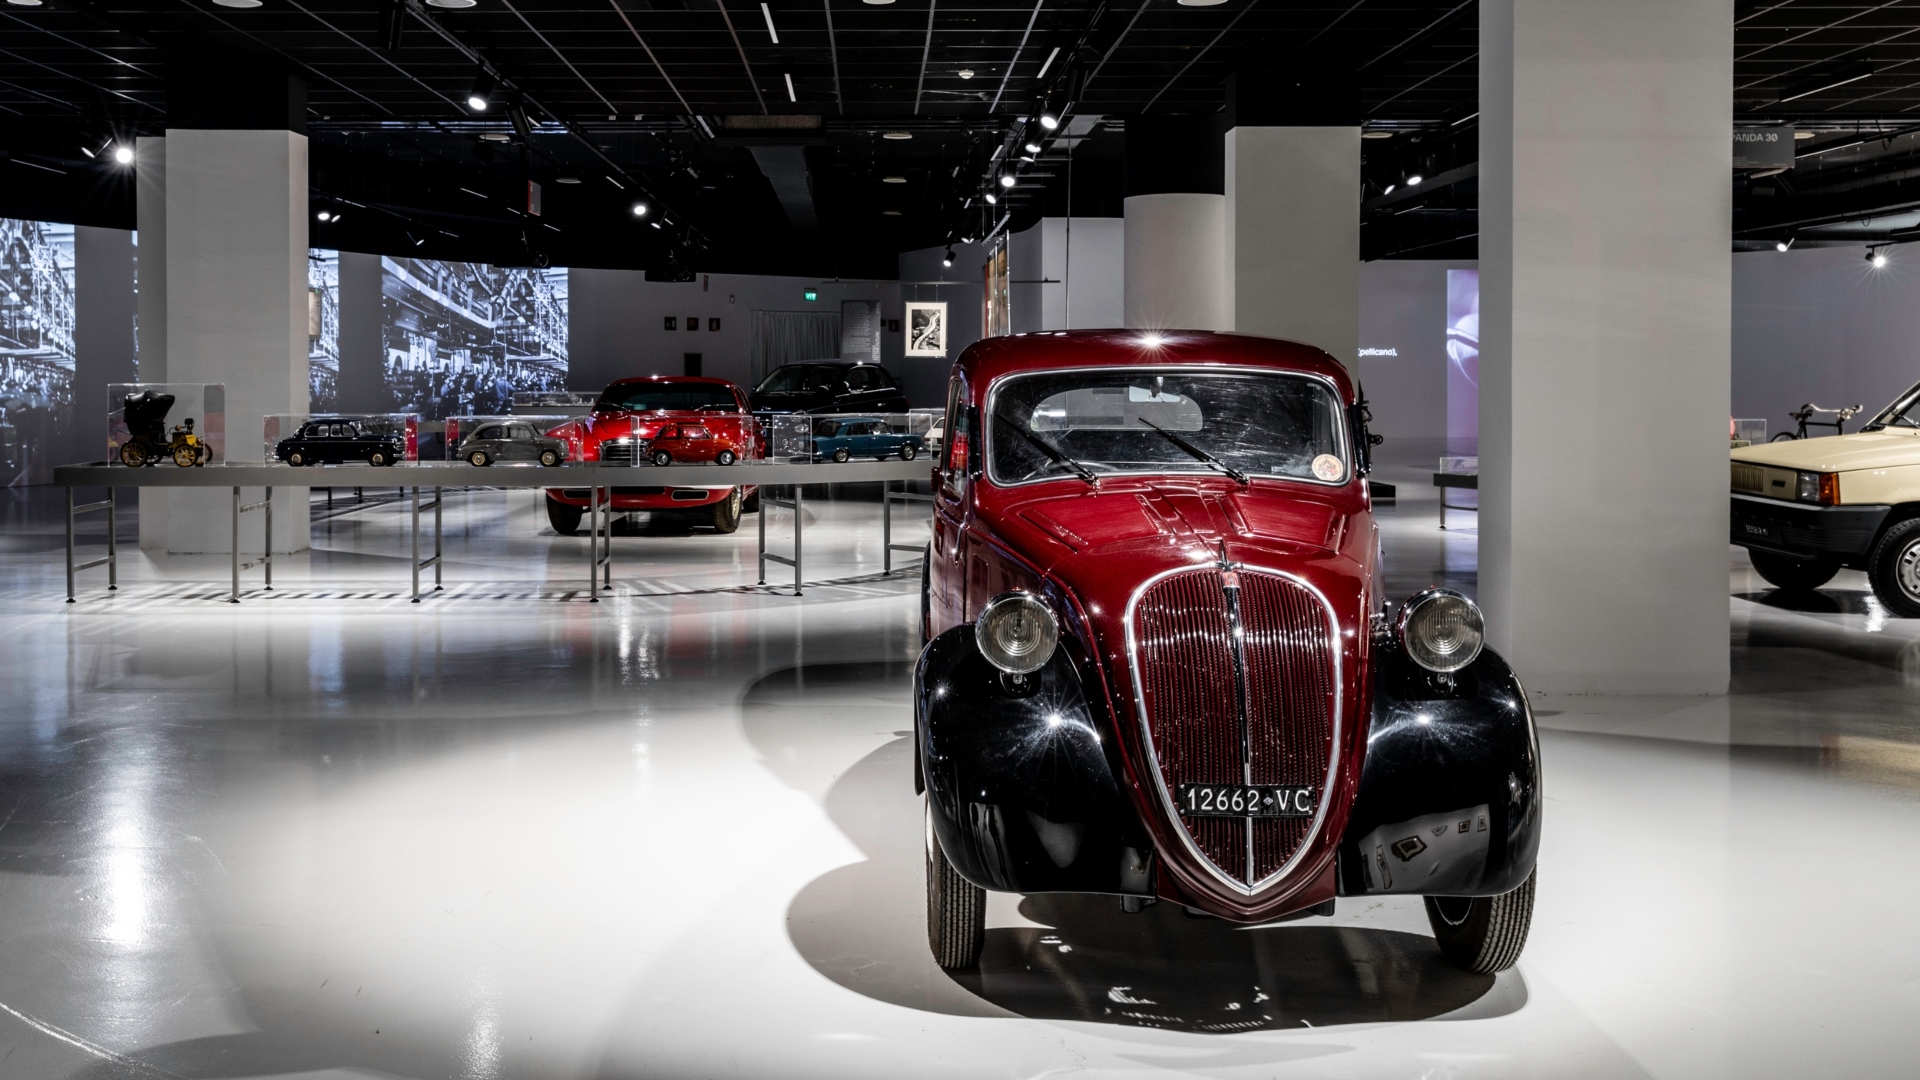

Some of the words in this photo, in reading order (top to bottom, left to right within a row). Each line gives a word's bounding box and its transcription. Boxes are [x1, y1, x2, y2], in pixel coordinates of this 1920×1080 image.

[1765, 133, 1778, 142] 30
[1187, 787, 1260, 812] 12662
[1276, 789, 1310, 812] VC
